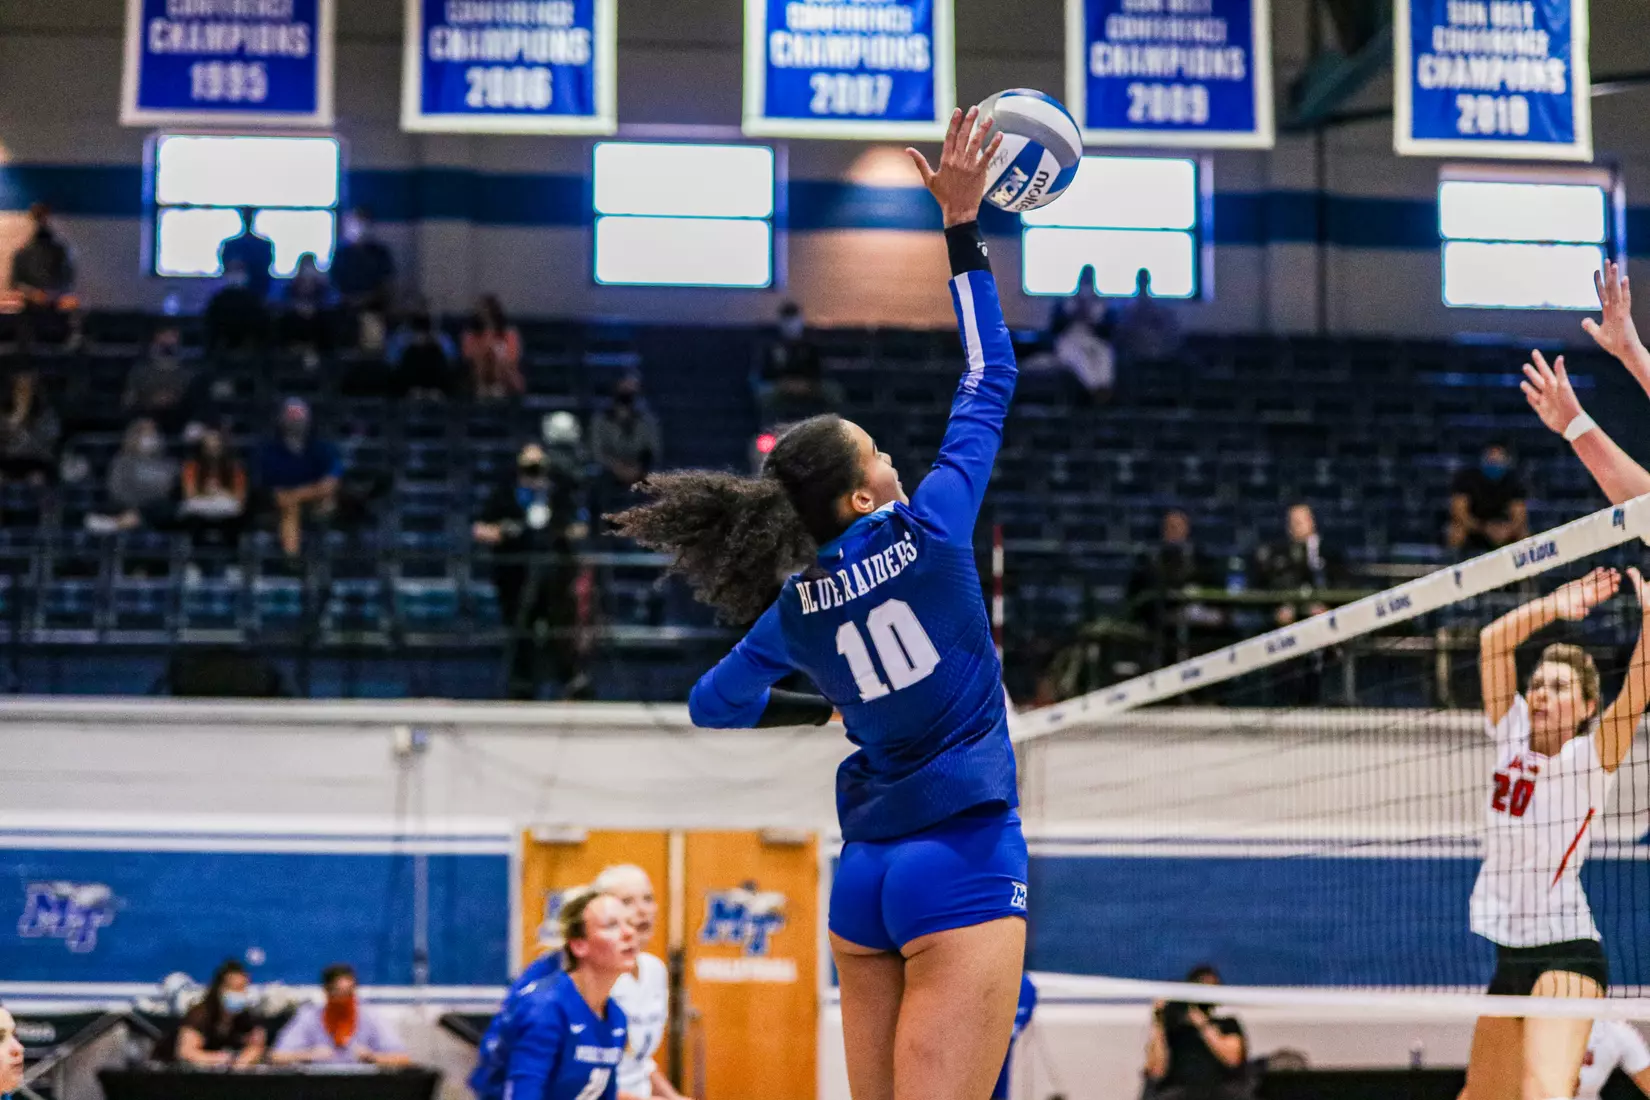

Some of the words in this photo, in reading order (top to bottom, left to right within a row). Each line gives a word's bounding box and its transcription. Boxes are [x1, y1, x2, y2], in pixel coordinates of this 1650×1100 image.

[149, 17, 310, 58] CHAMPIONS
[786, 2, 913, 32] CONFERENCE
[1105, 14, 1228, 42] CONFERENCE
[428, 25, 592, 66] CHAMPIONS
[769, 30, 930, 72] CHAMPIONS
[1090, 41, 1246, 81] CHAMPIONS
[1432, 25, 1549, 57] CONFERENCE
[190, 61, 268, 102] 1995
[465, 66, 552, 109] 2006
[809, 72, 893, 115] 2007
[1417, 53, 1567, 94] CHAMPIONS
[1126, 82, 1210, 125] 2009
[1456, 93, 1530, 135] 2010
[796, 577, 843, 615] BLUE
[837, 531, 918, 602] RAIDERS
[836, 598, 941, 703] 10
[1492, 772, 1536, 817] 20
[698, 890, 786, 956] MT
